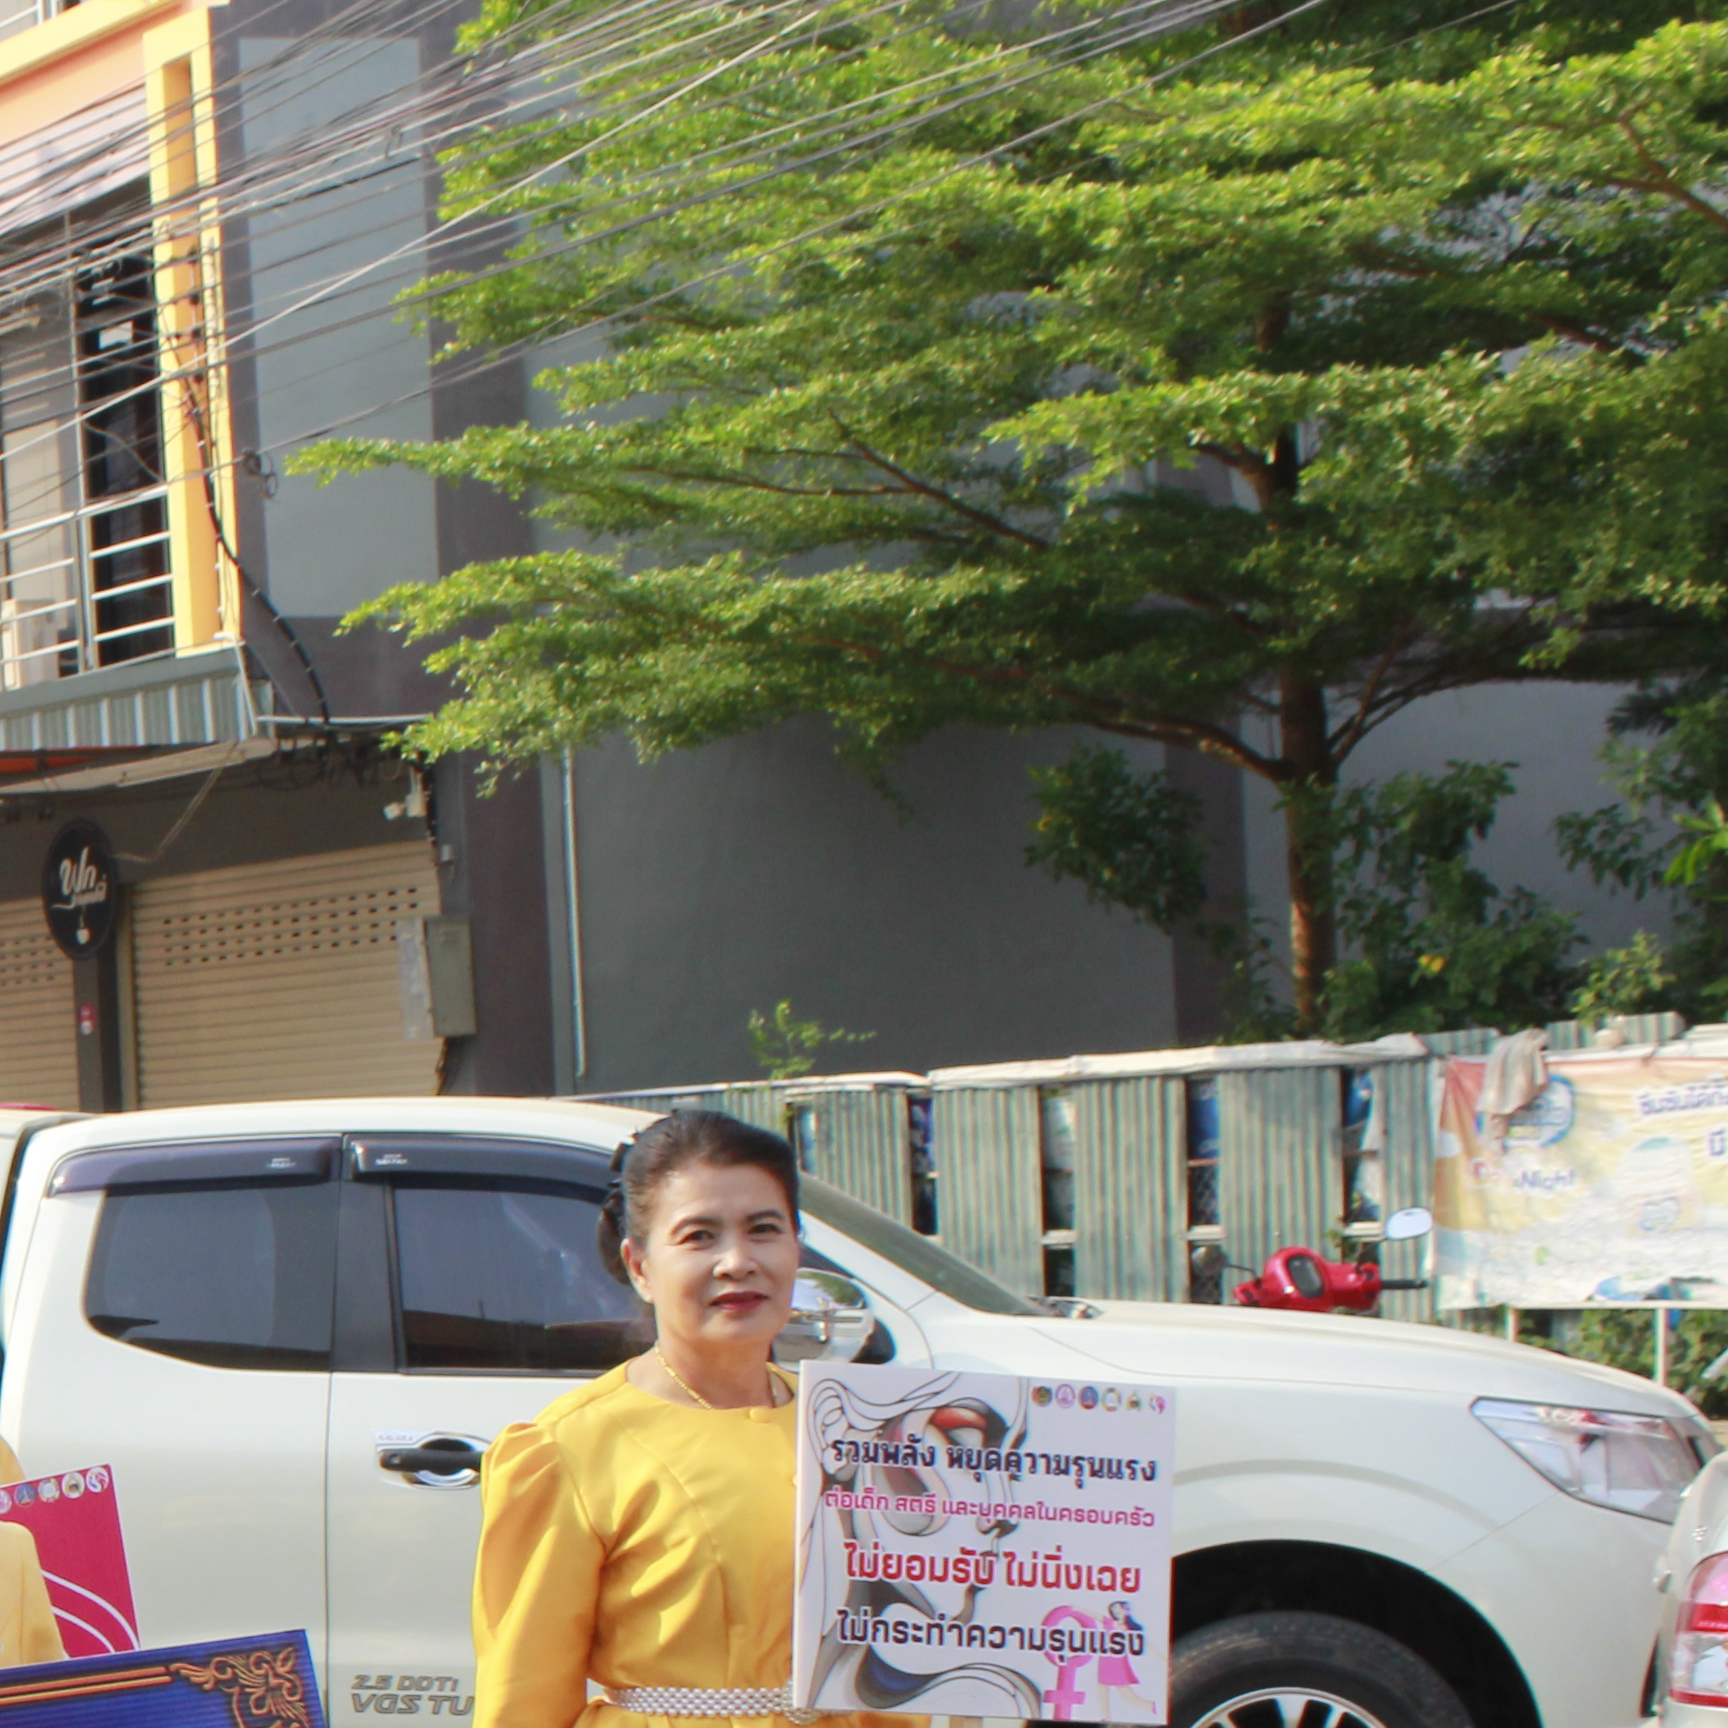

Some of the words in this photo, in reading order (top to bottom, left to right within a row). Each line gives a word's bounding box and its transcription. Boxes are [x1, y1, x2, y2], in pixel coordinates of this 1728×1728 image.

[830, 1434, 935, 1469] รวมพลัง
[825, 1487, 889, 1512] ต่อเด็ก
[895, 1491, 936, 1514] สตรี
[942, 1500, 1155, 1528] และบุคคลในครอบครัว
[844, 1541, 996, 1586] ไม่ยอมรับ
[1004, 1546, 1142, 1594] ไม่นิ่งเฉย
[837, 1609, 1146, 1664] ไม่กระทำความรุนแรง
[351, 1674, 393, 1690] 2.5
[351, 1693, 422, 1715] VGS
